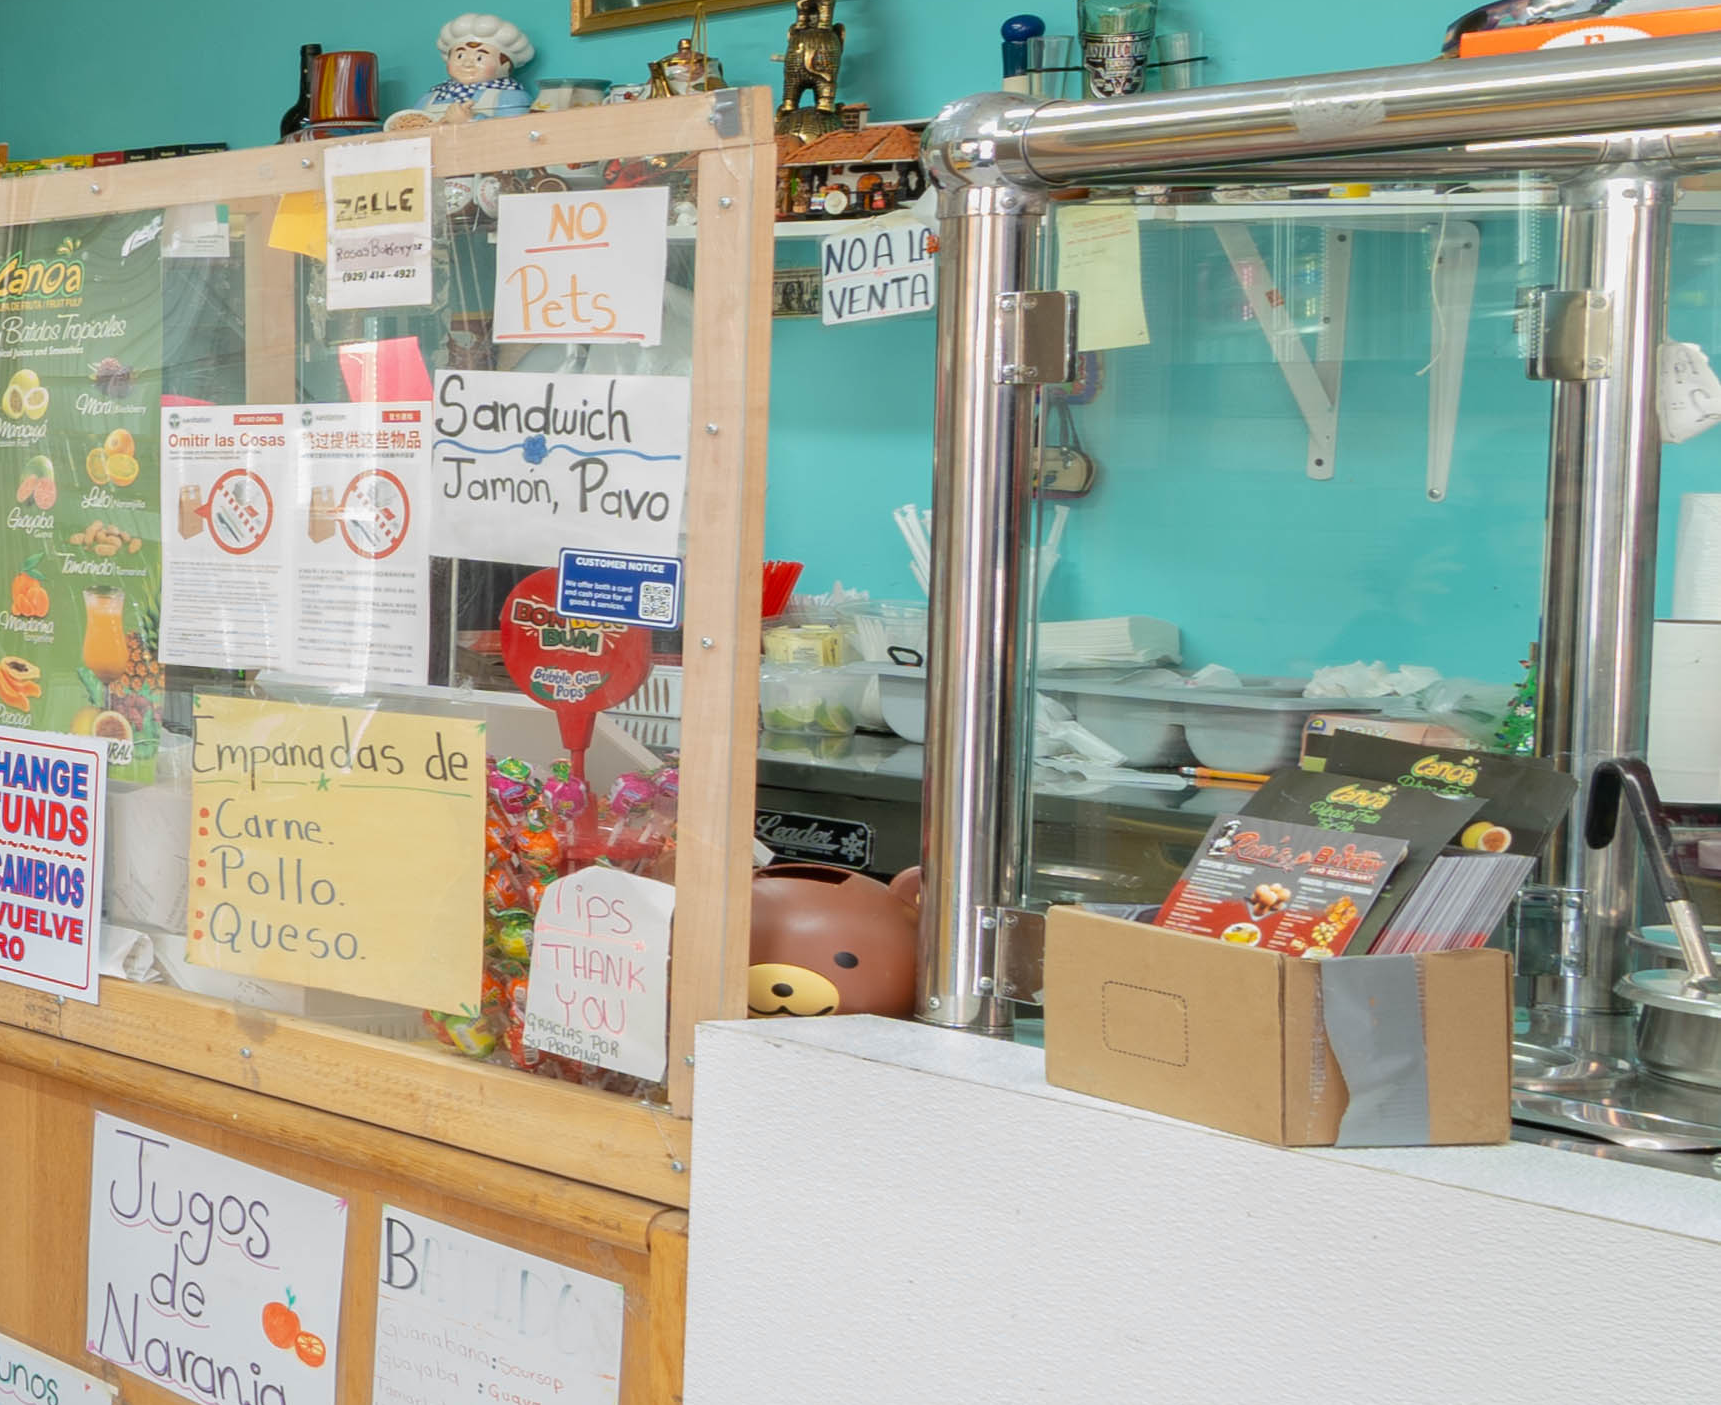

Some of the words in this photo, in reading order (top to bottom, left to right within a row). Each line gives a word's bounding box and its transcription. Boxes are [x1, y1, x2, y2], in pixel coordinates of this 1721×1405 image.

[548, 201, 608, 242] NO
[342, 270, 367, 282] (929)
[369, 269, 386, 280] 414
[394, 267, 416, 279] 4921
[824, 237, 867, 276] NO
[873, 232, 894, 268] A
[505, 264, 617, 333] Pets
[828, 273, 930, 319] VENTA
[57, 313, 127, 345] Tropicales
[76, 394, 112, 416] Mora
[435, 374, 631, 443] Sandwich
[168, 434, 210, 448] Omitir
[214, 434, 235, 447] las
[239, 433, 286, 447] Cosas
[569, 457, 670, 522] Pavo
[575, 556, 627, 570] CUSTOMER
[628, 562, 666, 574] NOTICE
[569, 599, 590, 607] goods
[597, 601, 626, 611] services.
[578, 581, 593, 589] offer
[594, 582, 611, 591] both
[617, 584, 634, 593] card
[578, 590, 593, 598] cash
[594, 592, 611, 600] price
[612, 593, 622, 601] for
[542, 628, 600, 653] BUM
[533, 668, 572, 685] Bubble
[575, 671, 600, 685] Gum
[556, 685, 585, 700] Pops
[192, 715, 404, 792] Empanadas
[425, 731, 469, 781] de
[1413, 754, 1479, 786] Canoa
[1326, 784, 1391, 810] Canoa
[215, 798, 334, 845] Carne.
[756, 814, 836, 847] Leader
[210, 845, 345, 906] Pollo.
[209, 902, 366, 960] Queso.
[541, 943, 646, 994] THANK
[555, 983, 626, 1034] YOU
[526, 1013, 584, 1044] GRACIAS
[590, 1034, 619, 1058] POR
[548, 1037, 601, 1065] PROPINA
[110, 1129, 271, 1266] Jugos
[150, 1243, 206, 1318] de
[377, 1344, 460, 1386] Guayaba
